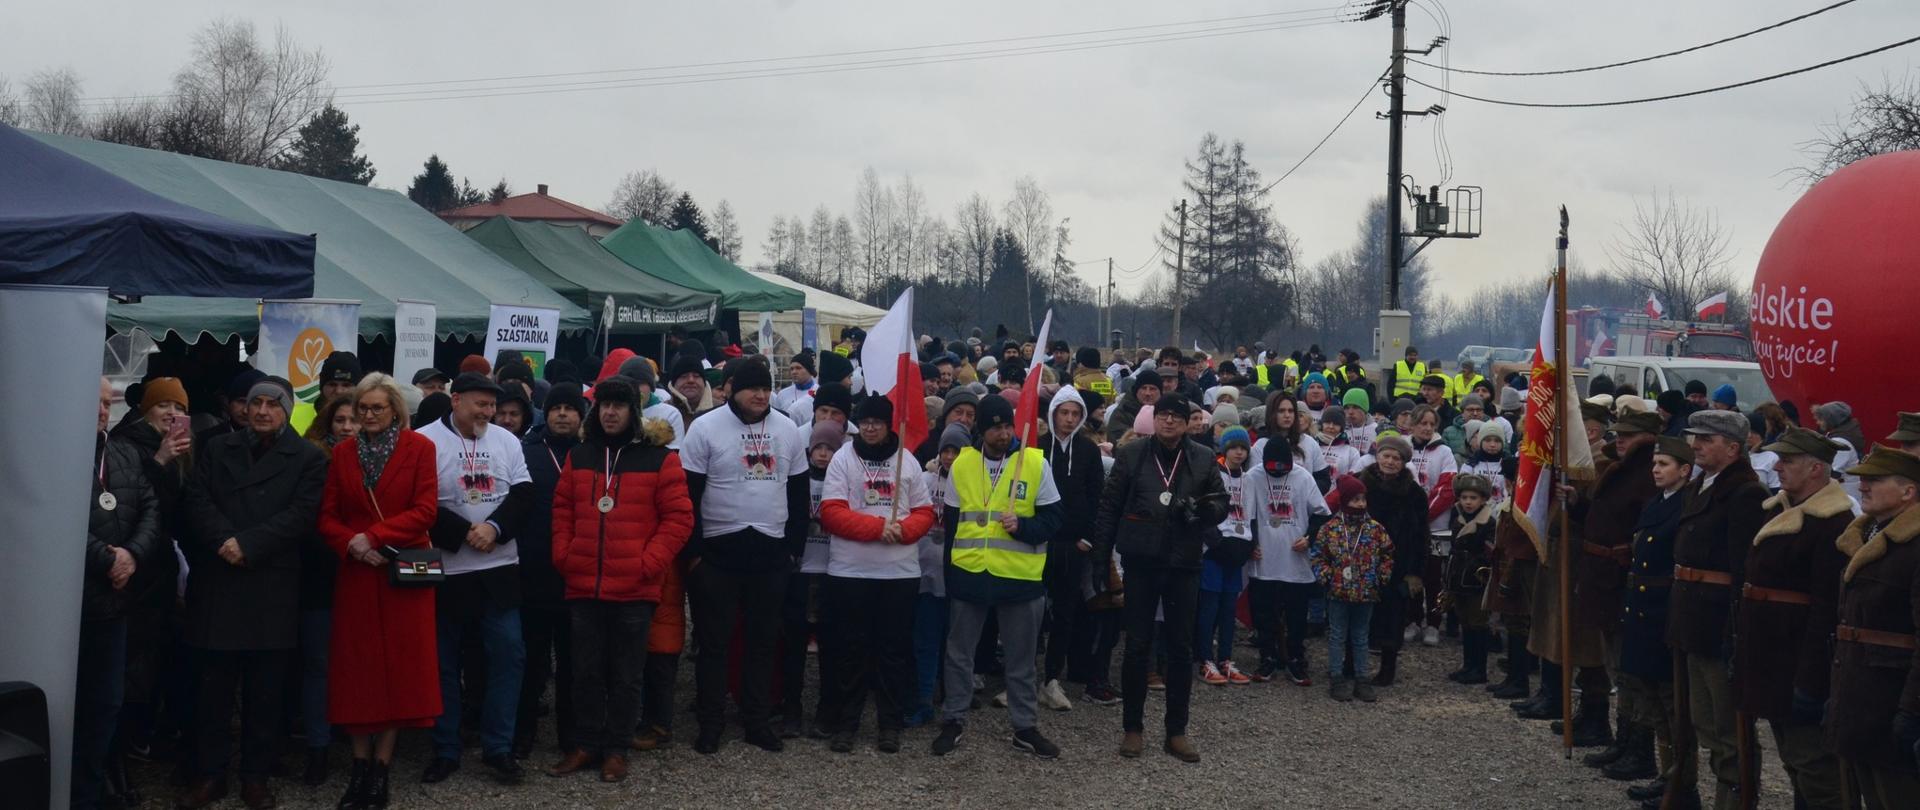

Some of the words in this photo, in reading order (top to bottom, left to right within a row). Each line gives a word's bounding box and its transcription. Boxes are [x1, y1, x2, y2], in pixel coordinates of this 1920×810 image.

[1750, 283, 1833, 330] elskie
[510, 314, 539, 328] GMINA
[497, 329, 549, 344] SZASTARKA
